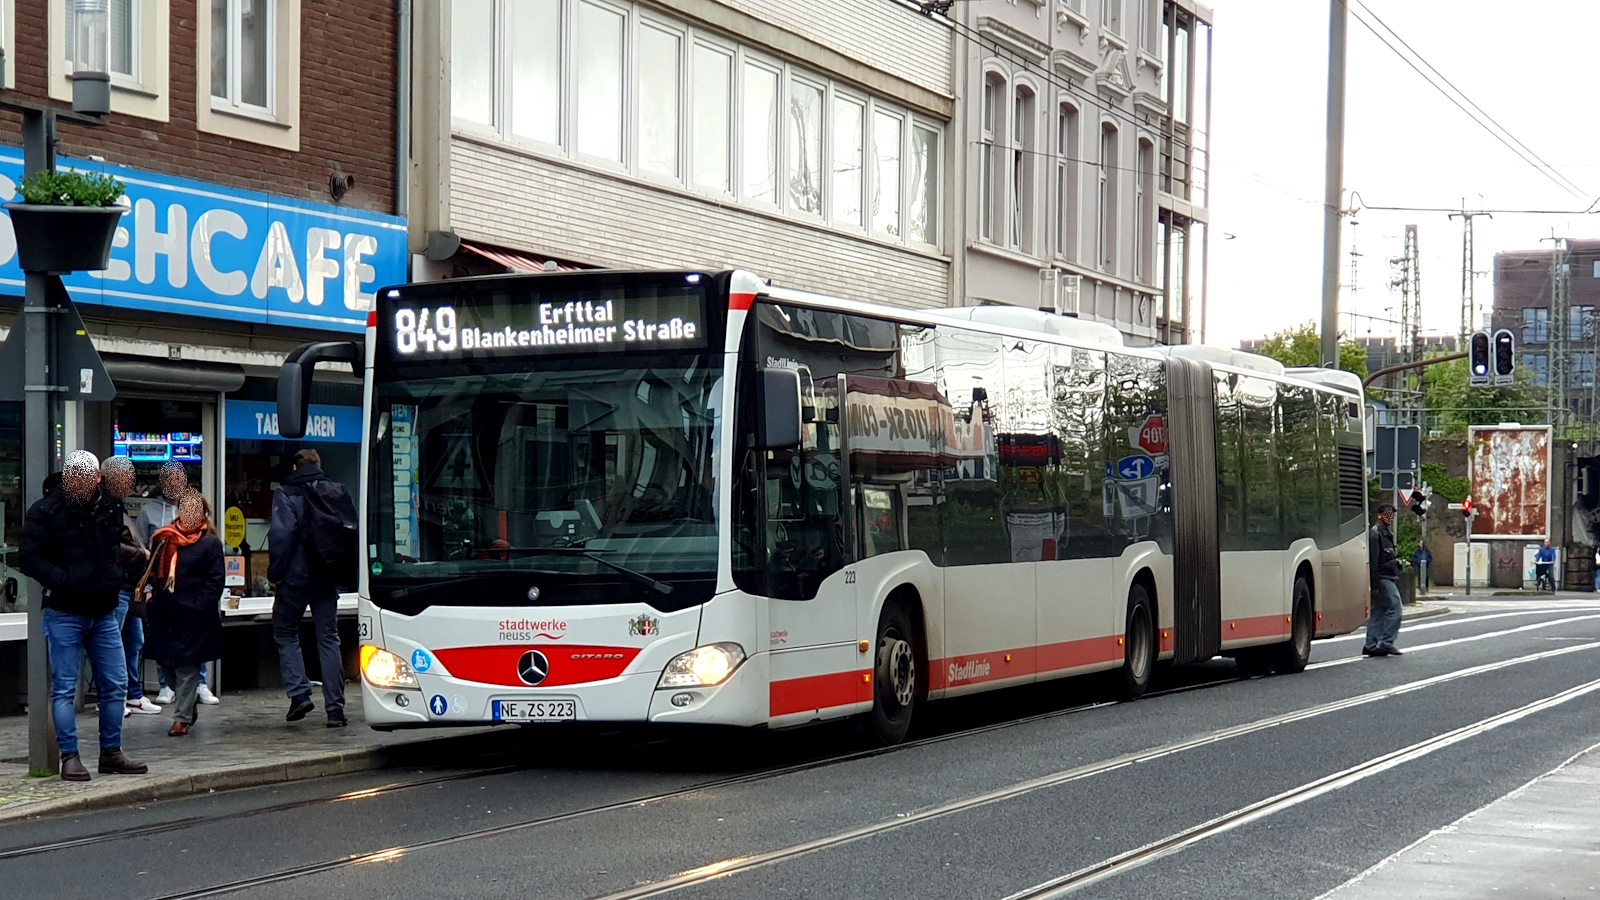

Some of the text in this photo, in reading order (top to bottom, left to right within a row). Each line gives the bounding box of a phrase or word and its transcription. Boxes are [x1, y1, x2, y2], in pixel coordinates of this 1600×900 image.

[539, 299, 614, 326] Erfttal
[395, 306, 458, 354] 849
[461, 318, 696, 349] Blankenheimer Straße
[845, 571, 857, 584] 223
[498, 618, 567, 632] stadtwerke
[499, 631, 531, 641] neuss
[570, 653, 625, 661] CITARO
[947, 658, 991, 683] StadtLinie
[501, 703, 574, 717] NE ZS 223
